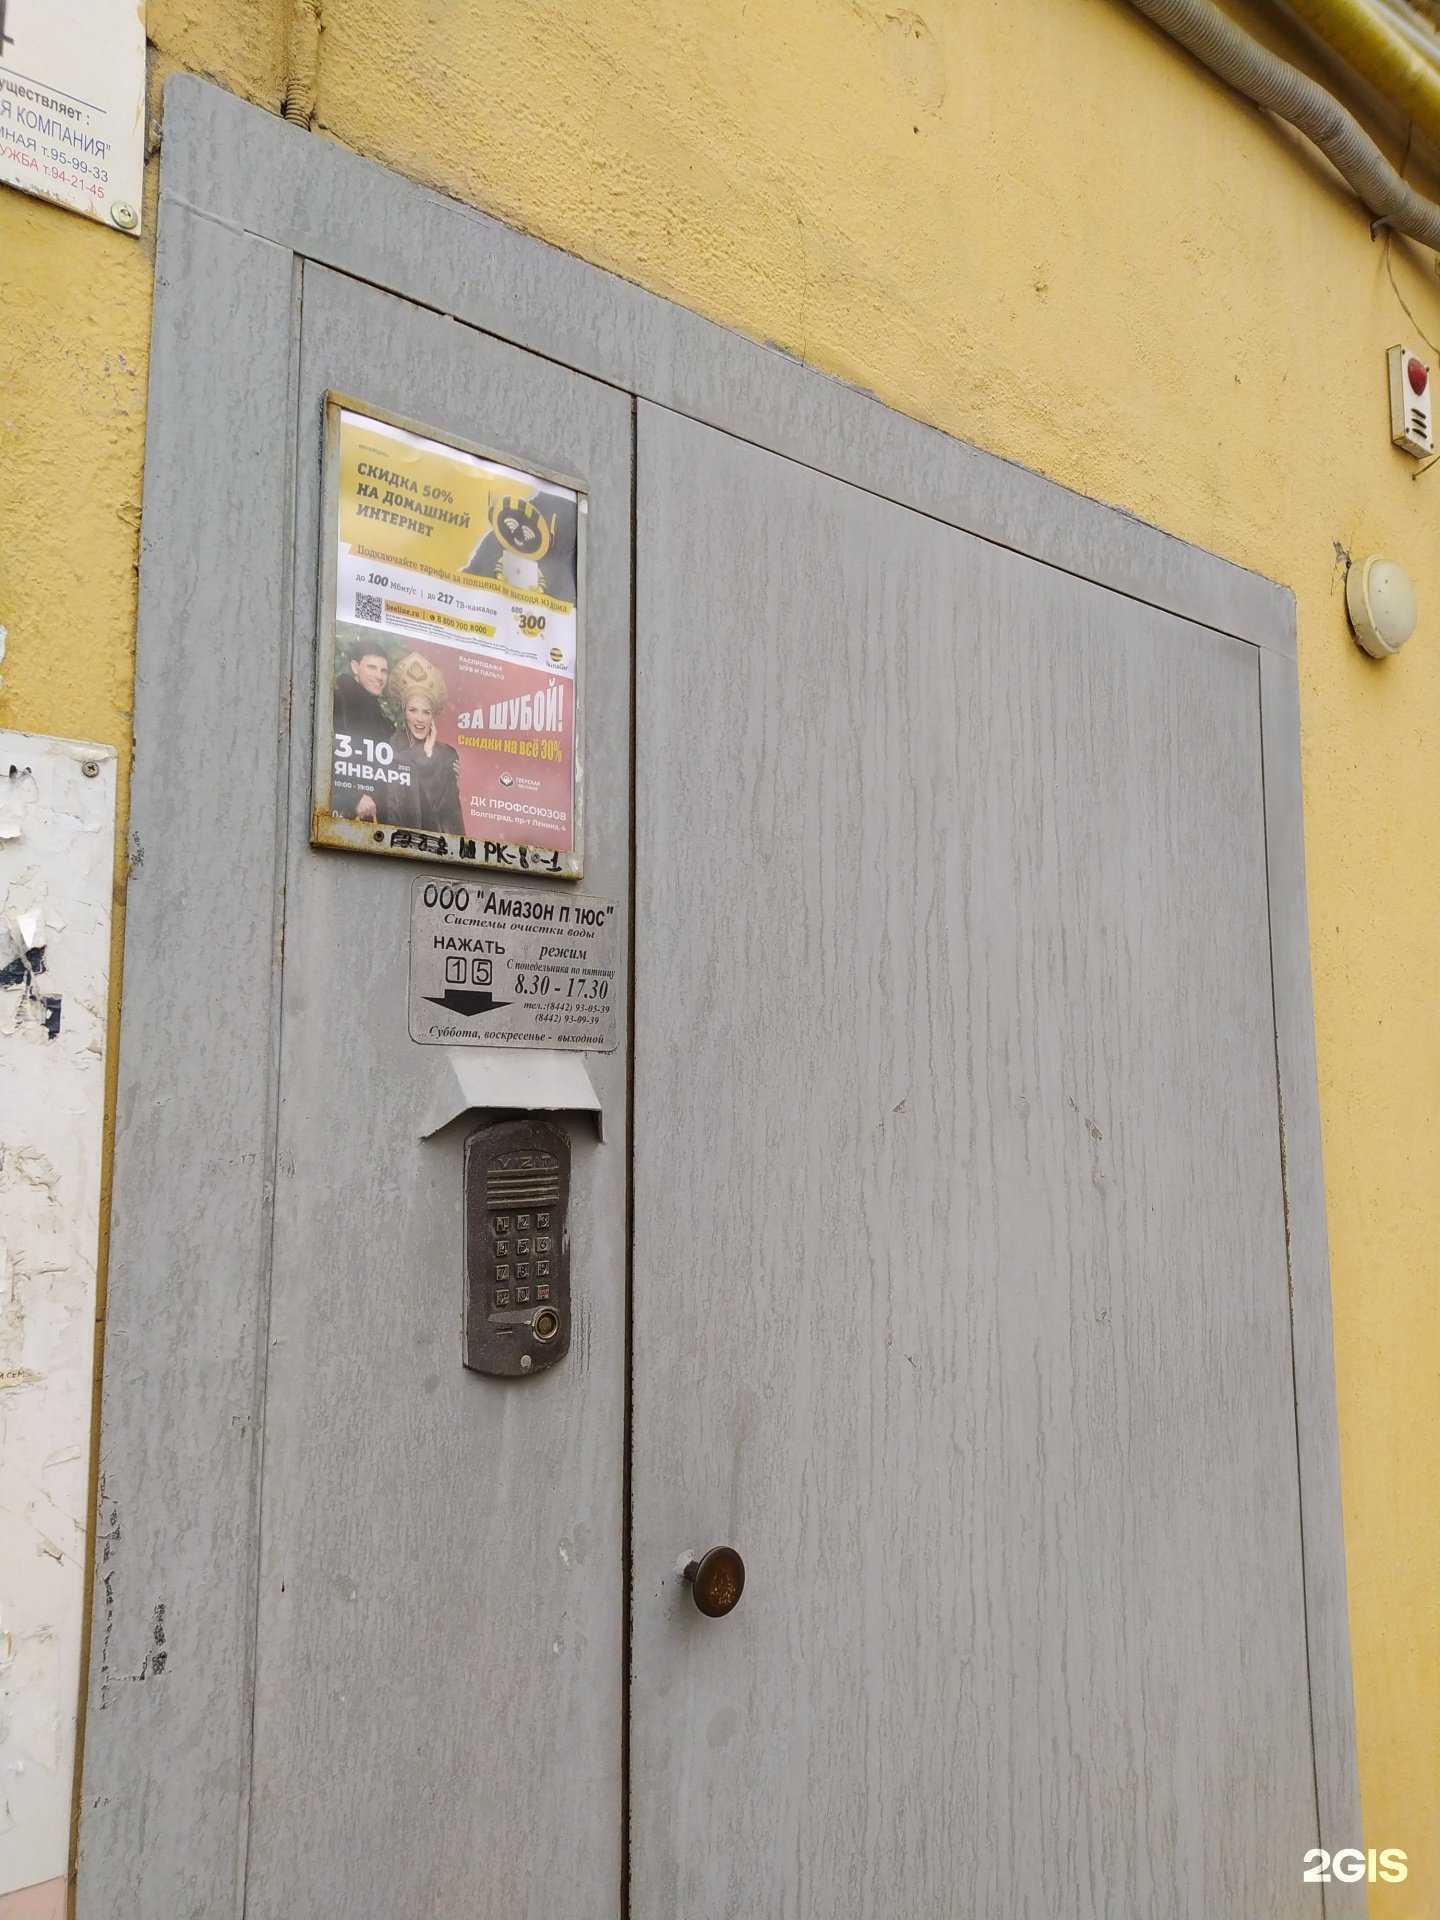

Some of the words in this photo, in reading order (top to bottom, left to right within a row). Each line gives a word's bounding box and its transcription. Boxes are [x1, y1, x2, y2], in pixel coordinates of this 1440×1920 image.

[41, 145, 109, 184] т.95-99-33
[43, 163, 105, 199] т.94-21-45
[357, 462, 418, 493] СКИДКА
[423, 484, 454, 505] 50%
[356, 482, 379, 500] НА
[382, 490, 471, 528] ДОМАШНИЙ
[356, 503, 434, 537] ИНТЕРНЕТ
[357, 543, 418, 570] Подключайте
[419, 563, 452, 580] тарифы
[452, 573, 462, 584] за
[356, 574, 366, 582] до
[367, 572, 389, 588] 100
[427, 592, 436, 600] до
[437, 592, 455, 606] 217
[456, 600, 498, 616] ТВ-каналов
[518, 614, 546, 630] 300
[457, 708, 484, 730] ЗА
[489, 678, 564, 732] ШУБОЙ!
[334, 734, 394, 766] 3-10
[540, 739, 562, 762] 30%
[334, 760, 411, 786] ЯНВАРЯ
[470, 796, 487, 808] ДК
[489, 798, 567, 821] ПРОФСОЮЗОВ
[424, 884, 470, 912] ООО
[477, 889, 554, 921] "Амазон
[444, 913, 506, 930] Системы
[510, 923, 564, 937] очистки
[567, 927, 595, 939] воды
[433, 935, 506, 955] НАЖАТЬ
[539, 944, 588, 961] режим
[514, 962, 569, 974] понедельника
[570, 966, 580, 974] по
[582, 967, 616, 980] пятницу
[514, 973, 550, 996] 8.30
[566, 978, 609, 1000] 17.30
[534, 1013, 562, 1024] (8442)
[428, 1026, 480, 1040] Суббота,
[484, 1030, 546, 1042] воскресенье
[557, 1032, 604, 1044] выходной
